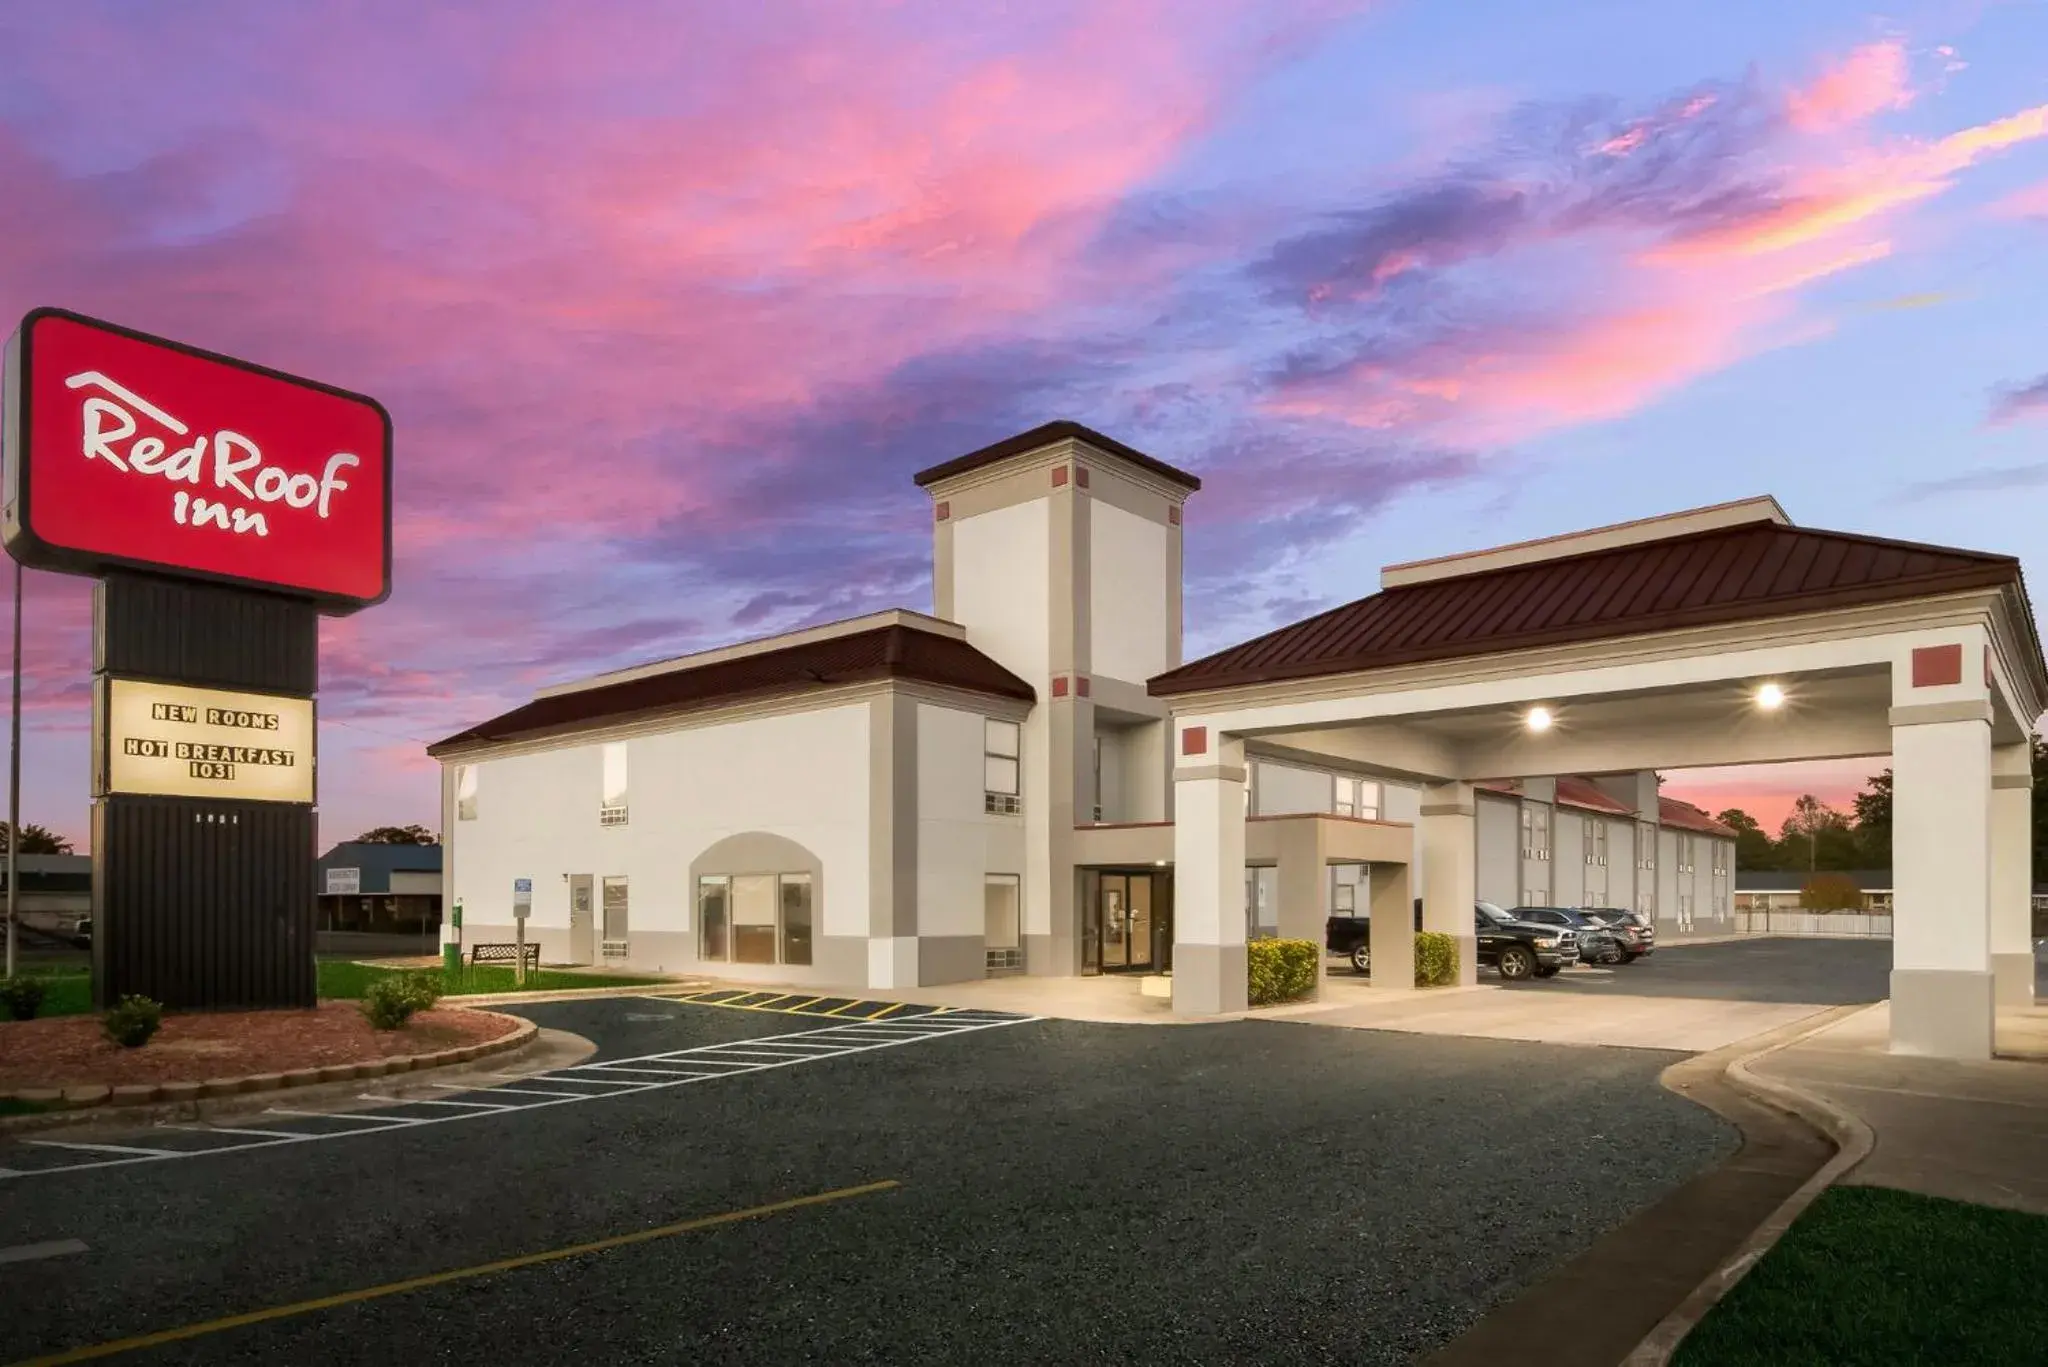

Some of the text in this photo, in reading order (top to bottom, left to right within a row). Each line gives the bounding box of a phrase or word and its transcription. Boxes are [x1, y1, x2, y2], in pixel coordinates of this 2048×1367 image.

[83, 398, 360, 519] Red Roof
[153, 704, 279, 730] NEW ROOMS
[124, 739, 294, 766] HOT BREAKFAST
[190, 763, 235, 779] 1031
